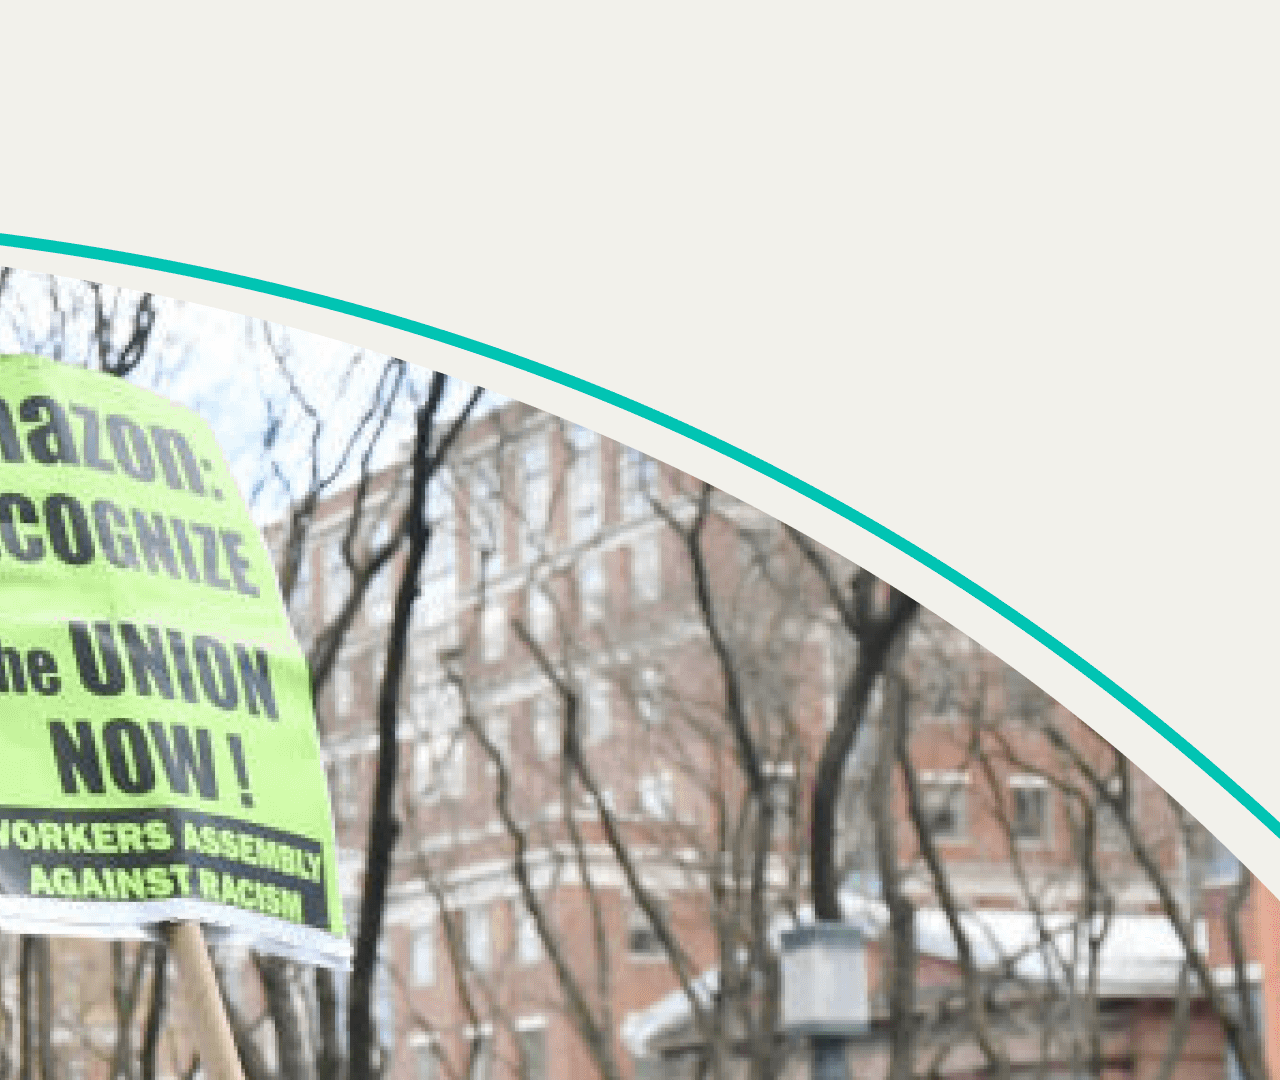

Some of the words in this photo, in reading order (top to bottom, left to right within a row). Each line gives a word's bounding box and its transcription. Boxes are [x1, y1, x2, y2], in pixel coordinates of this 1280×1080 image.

[68, 619, 280, 723] UNION
[183, 823, 322, 884] ASSEMBLY
[29, 862, 192, 900] AGAINST
[198, 873, 306, 923] RACISM
